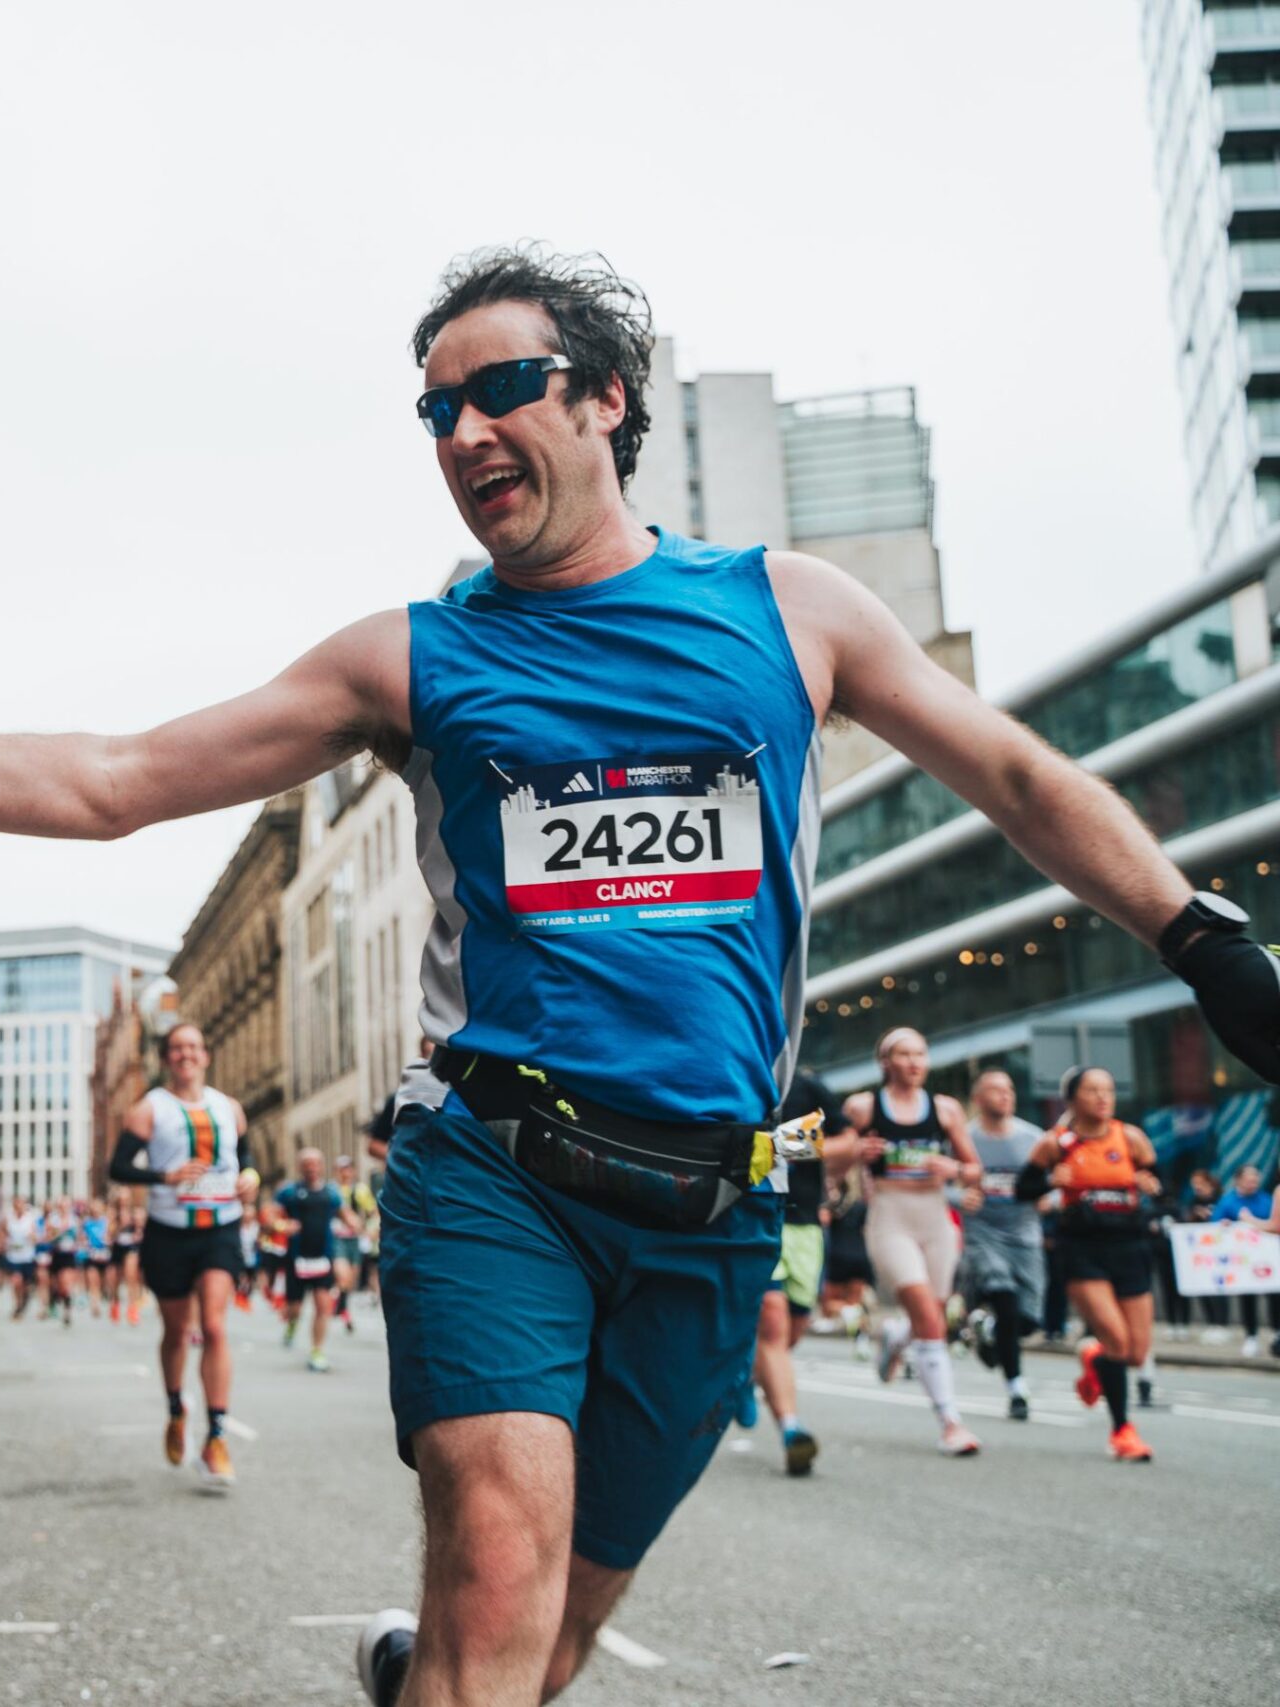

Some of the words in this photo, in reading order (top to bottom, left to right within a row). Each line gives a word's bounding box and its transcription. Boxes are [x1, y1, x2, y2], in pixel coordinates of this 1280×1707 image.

[626, 765, 692, 777] MANCHESTER
[626, 774, 693, 787] MARATHON
[541, 808, 724, 873] 24261
[596, 880, 674, 901] CLANCY
[578, 914, 602, 924] BLUE
